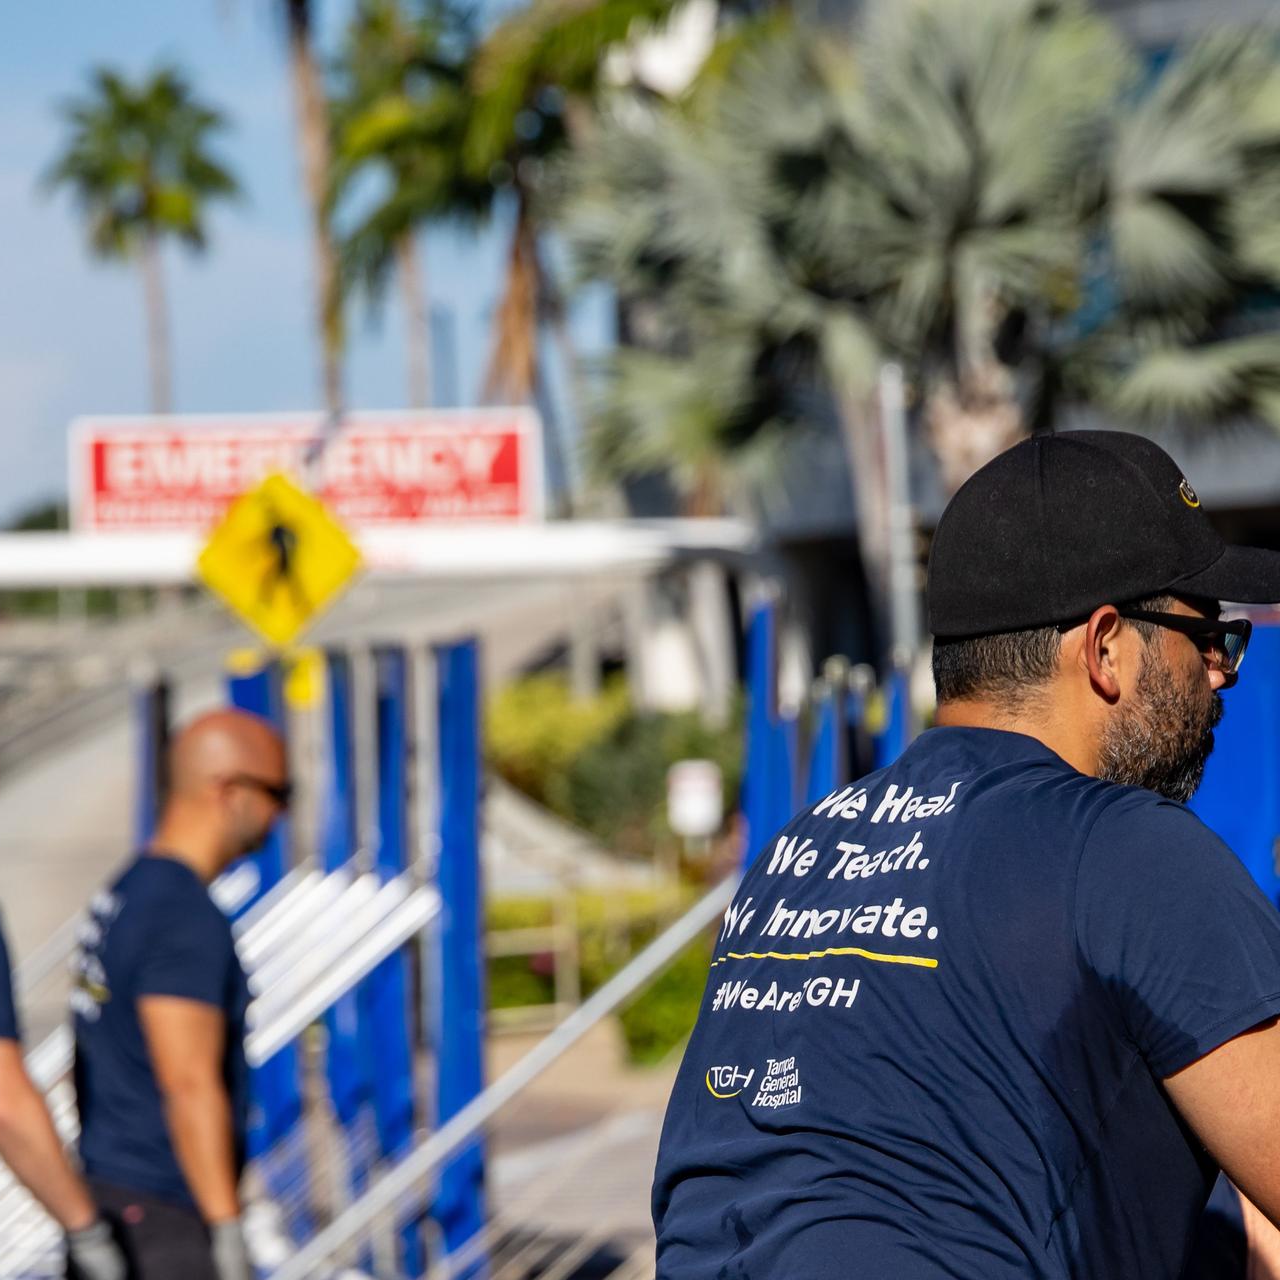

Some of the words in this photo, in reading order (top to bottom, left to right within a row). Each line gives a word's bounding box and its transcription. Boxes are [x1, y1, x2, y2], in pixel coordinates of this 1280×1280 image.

[812, 786, 867, 819] We
[870, 781, 963, 824] Heal.
[766, 835, 819, 878] We
[827, 830, 930, 881] Teach.
[760, 897, 939, 940] Innovate.
[712, 976, 860, 1012] #WeAreTGH
[710, 1065, 755, 1089] TGH
[760, 1068, 799, 1092] General
[766, 1056, 795, 1076] Tampa
[751, 1086, 802, 1110] Hospital
